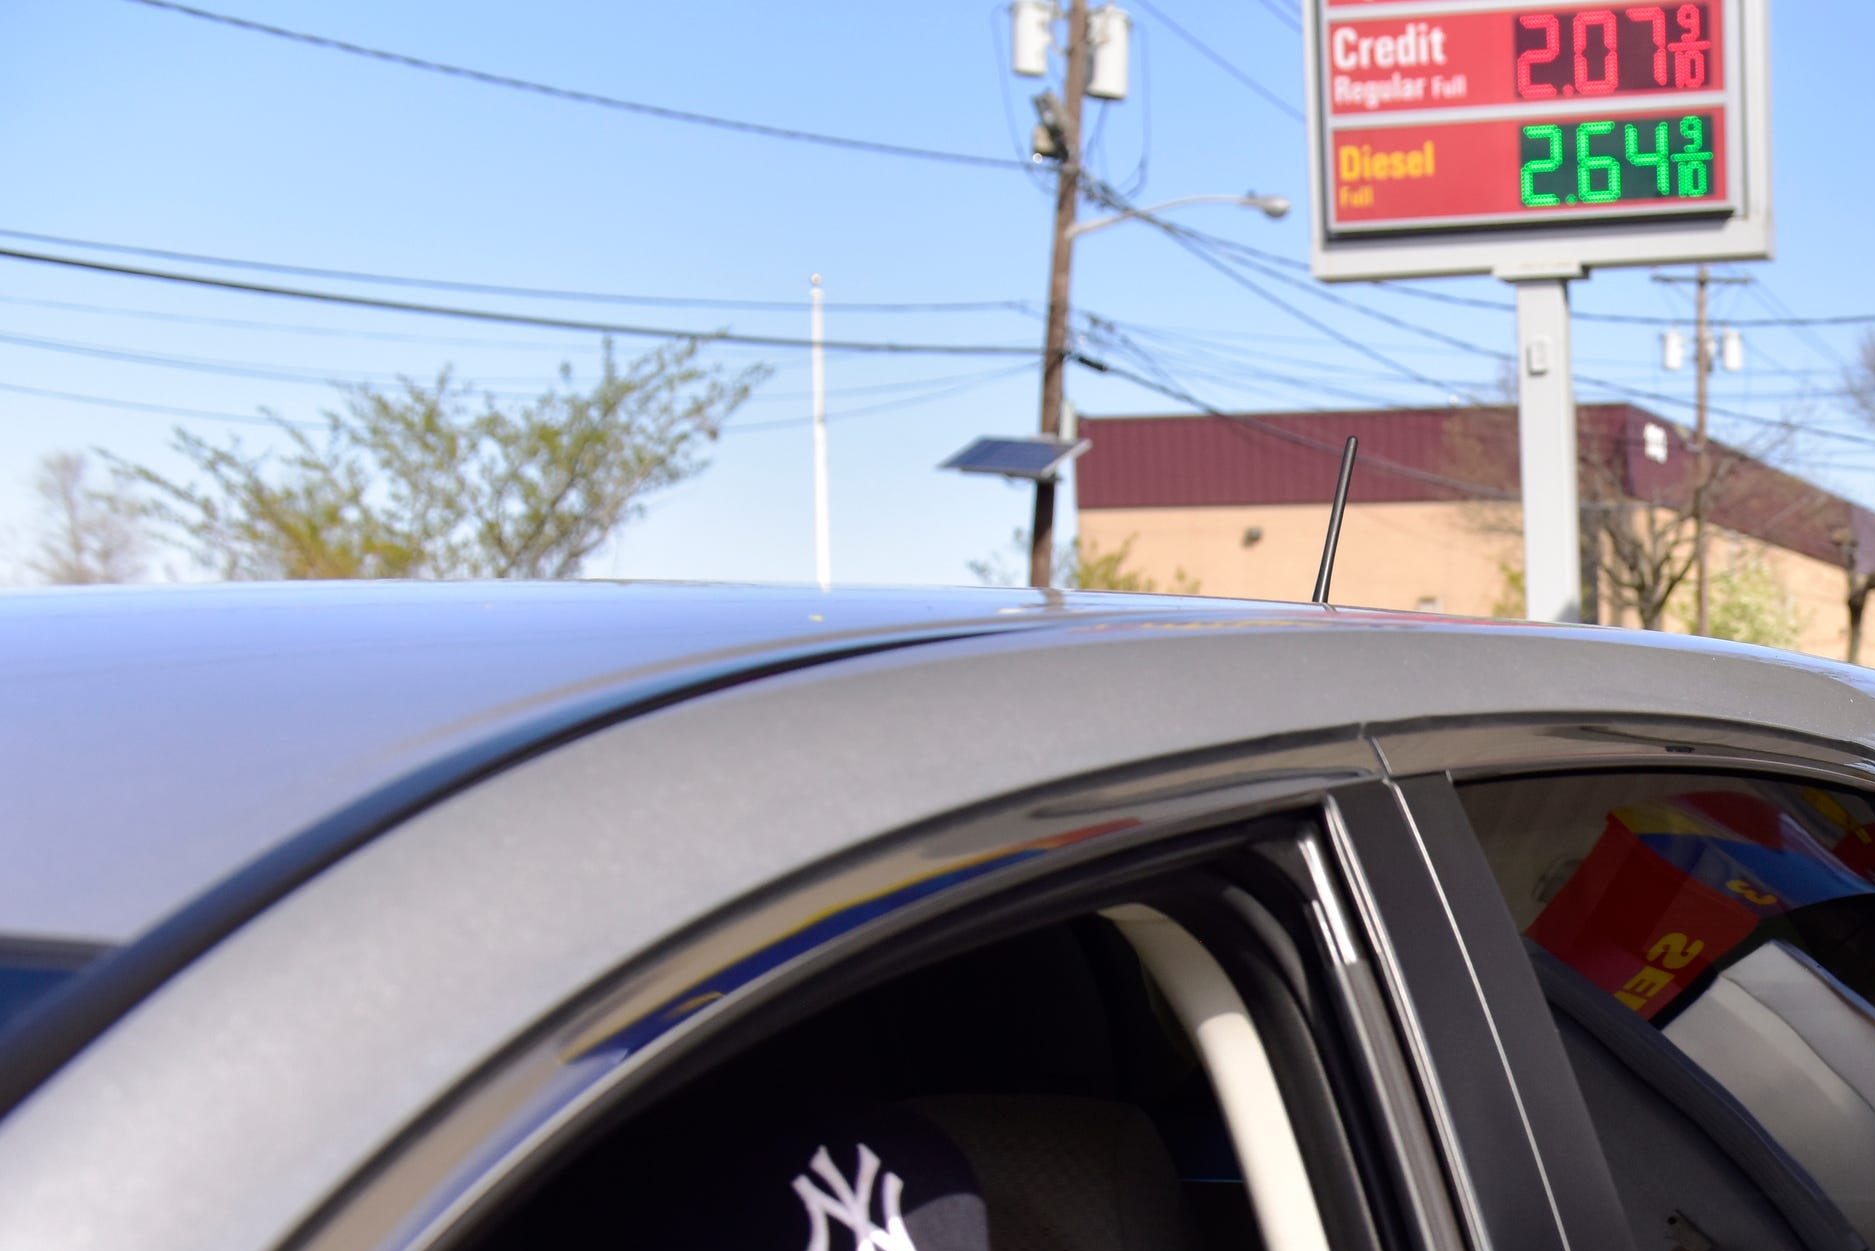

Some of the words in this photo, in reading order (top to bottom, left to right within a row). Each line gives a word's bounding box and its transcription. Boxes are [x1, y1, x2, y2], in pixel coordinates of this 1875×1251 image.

[1333, 23, 1447, 71] Credit
[1517, 7, 1667, 98] 2.07
[1334, 71, 1427, 109] Regular
[1431, 74, 1468, 99] Full
[1339, 139, 1436, 182] Diesel
[1520, 121, 1670, 206] 2.64
[1339, 184, 1375, 209] Full
